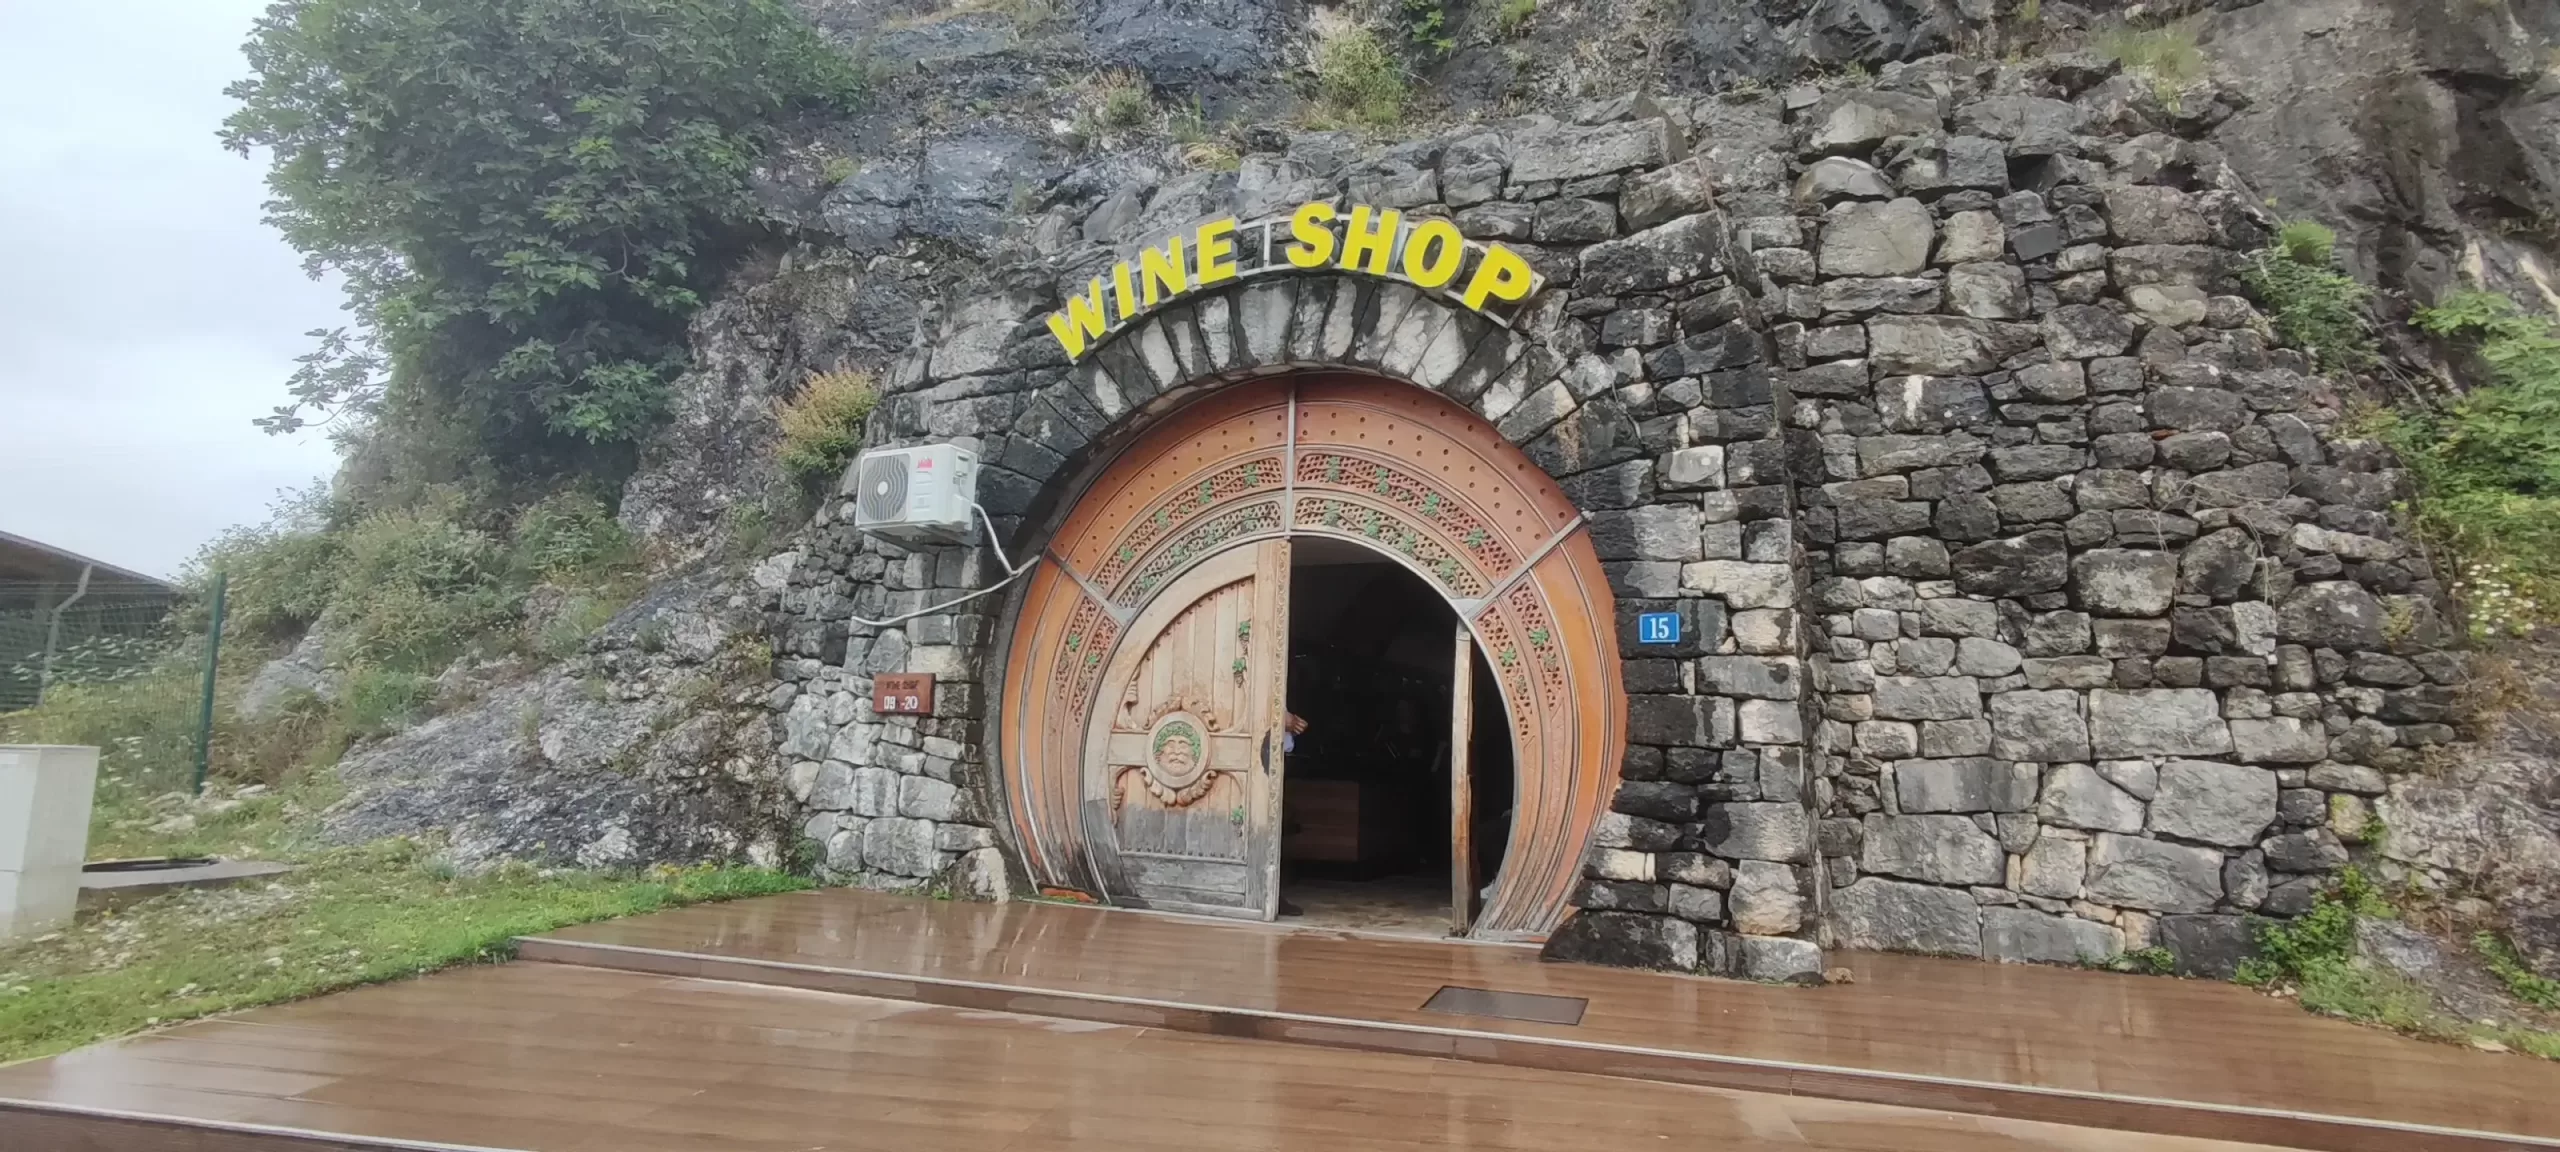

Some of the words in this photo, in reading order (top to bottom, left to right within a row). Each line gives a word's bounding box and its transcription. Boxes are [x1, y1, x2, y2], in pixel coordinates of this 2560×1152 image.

[1047, 217, 1237, 358] WINE
[1286, 202, 1535, 311] SHOP
[1650, 617, 1669, 639] 15
